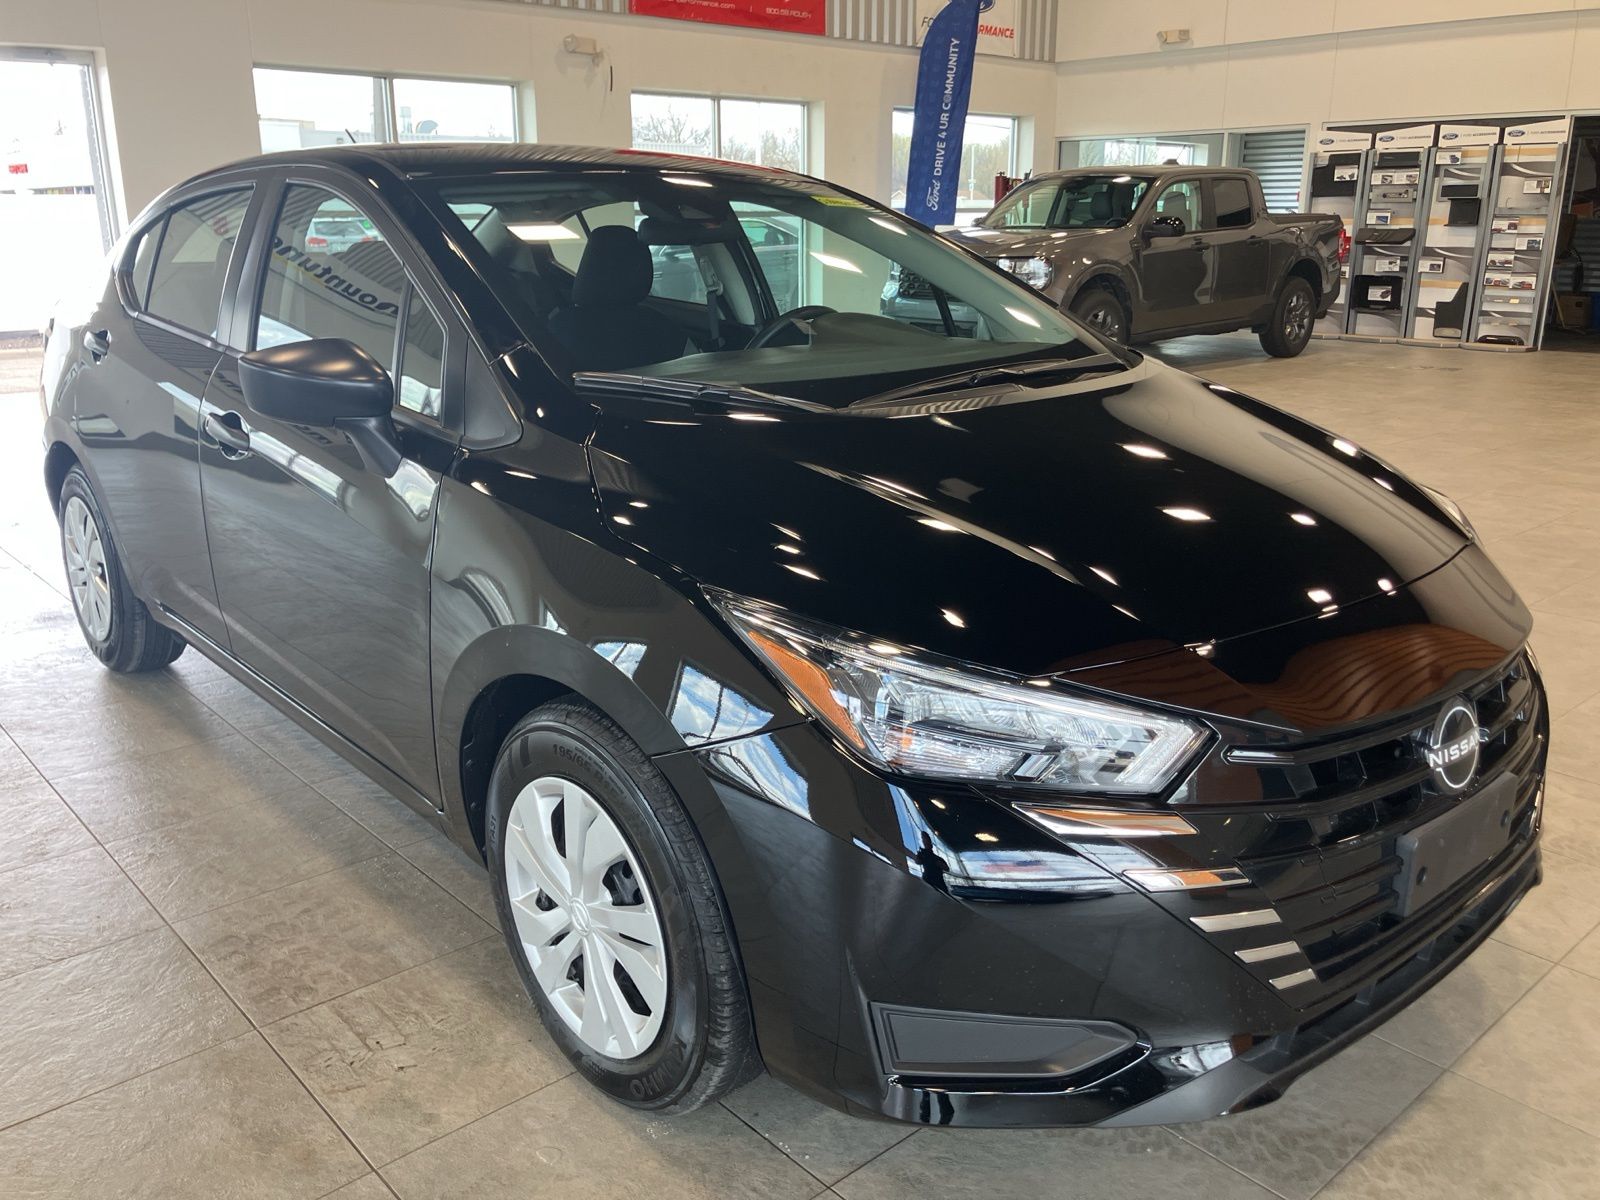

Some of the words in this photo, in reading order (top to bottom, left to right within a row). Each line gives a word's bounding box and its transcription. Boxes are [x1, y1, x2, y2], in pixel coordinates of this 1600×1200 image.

[978, 24, 1015, 39] RMANCE
[942, 38, 960, 110] COMMUNITY
[939, 112, 949, 130] UR
[939, 130, 947, 139] 4
[934, 141, 946, 177] DRIVE
[926, 180, 941, 211] Ford
